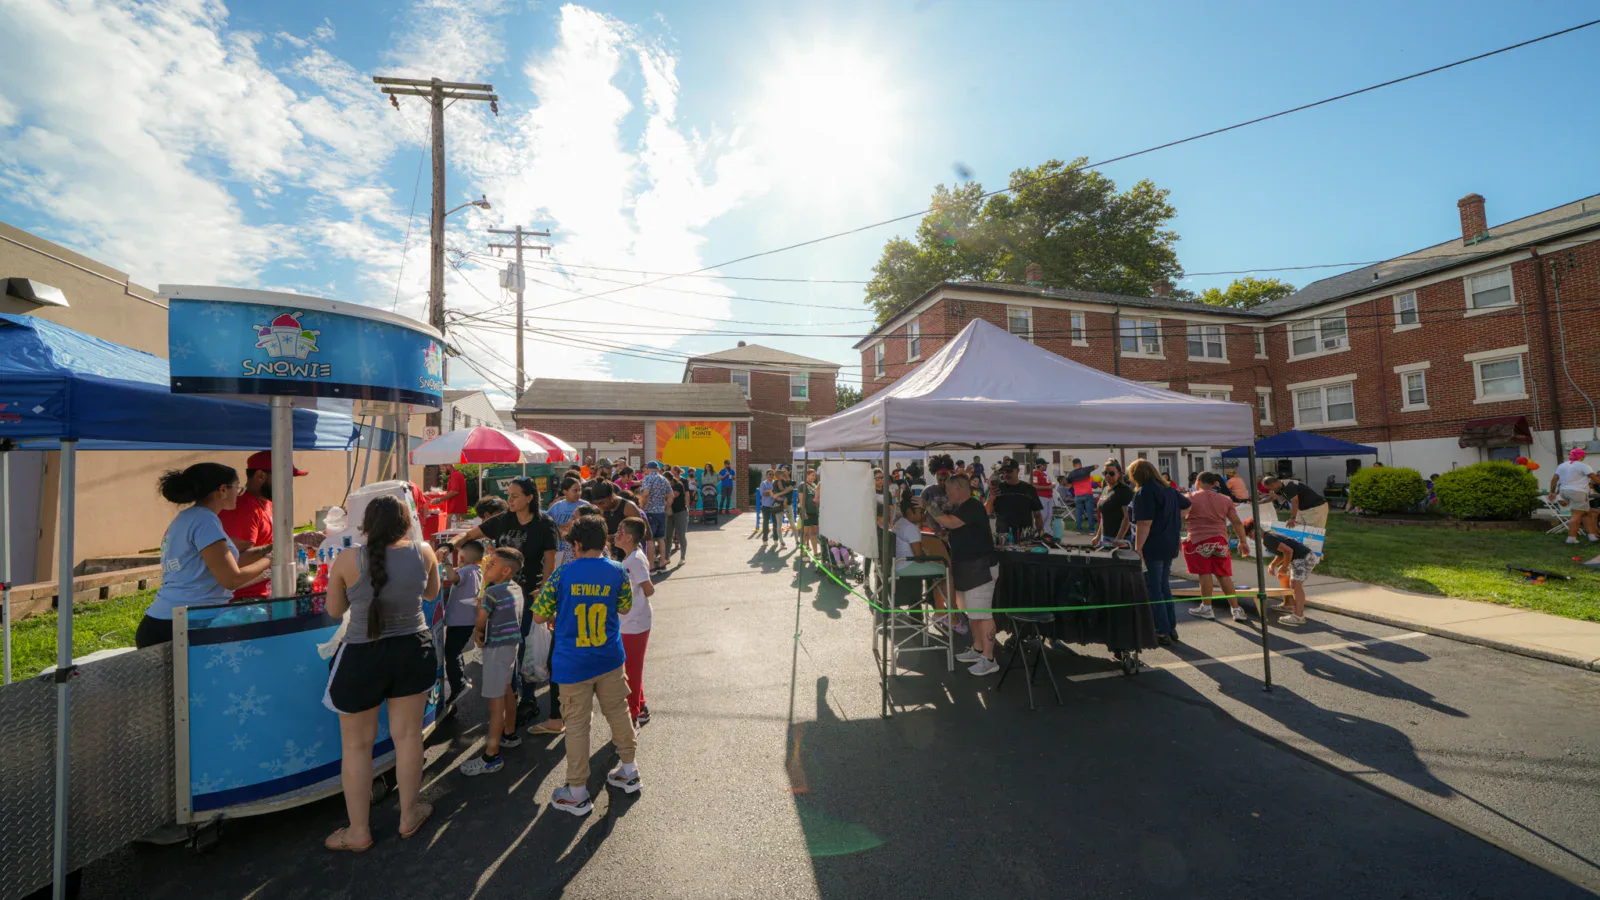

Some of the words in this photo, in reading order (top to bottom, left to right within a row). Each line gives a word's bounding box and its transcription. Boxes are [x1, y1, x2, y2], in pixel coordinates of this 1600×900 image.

[242, 359, 331, 378] SNOWIE
[571, 584, 600, 596] NEYMAR
[574, 603, 607, 648] 10
